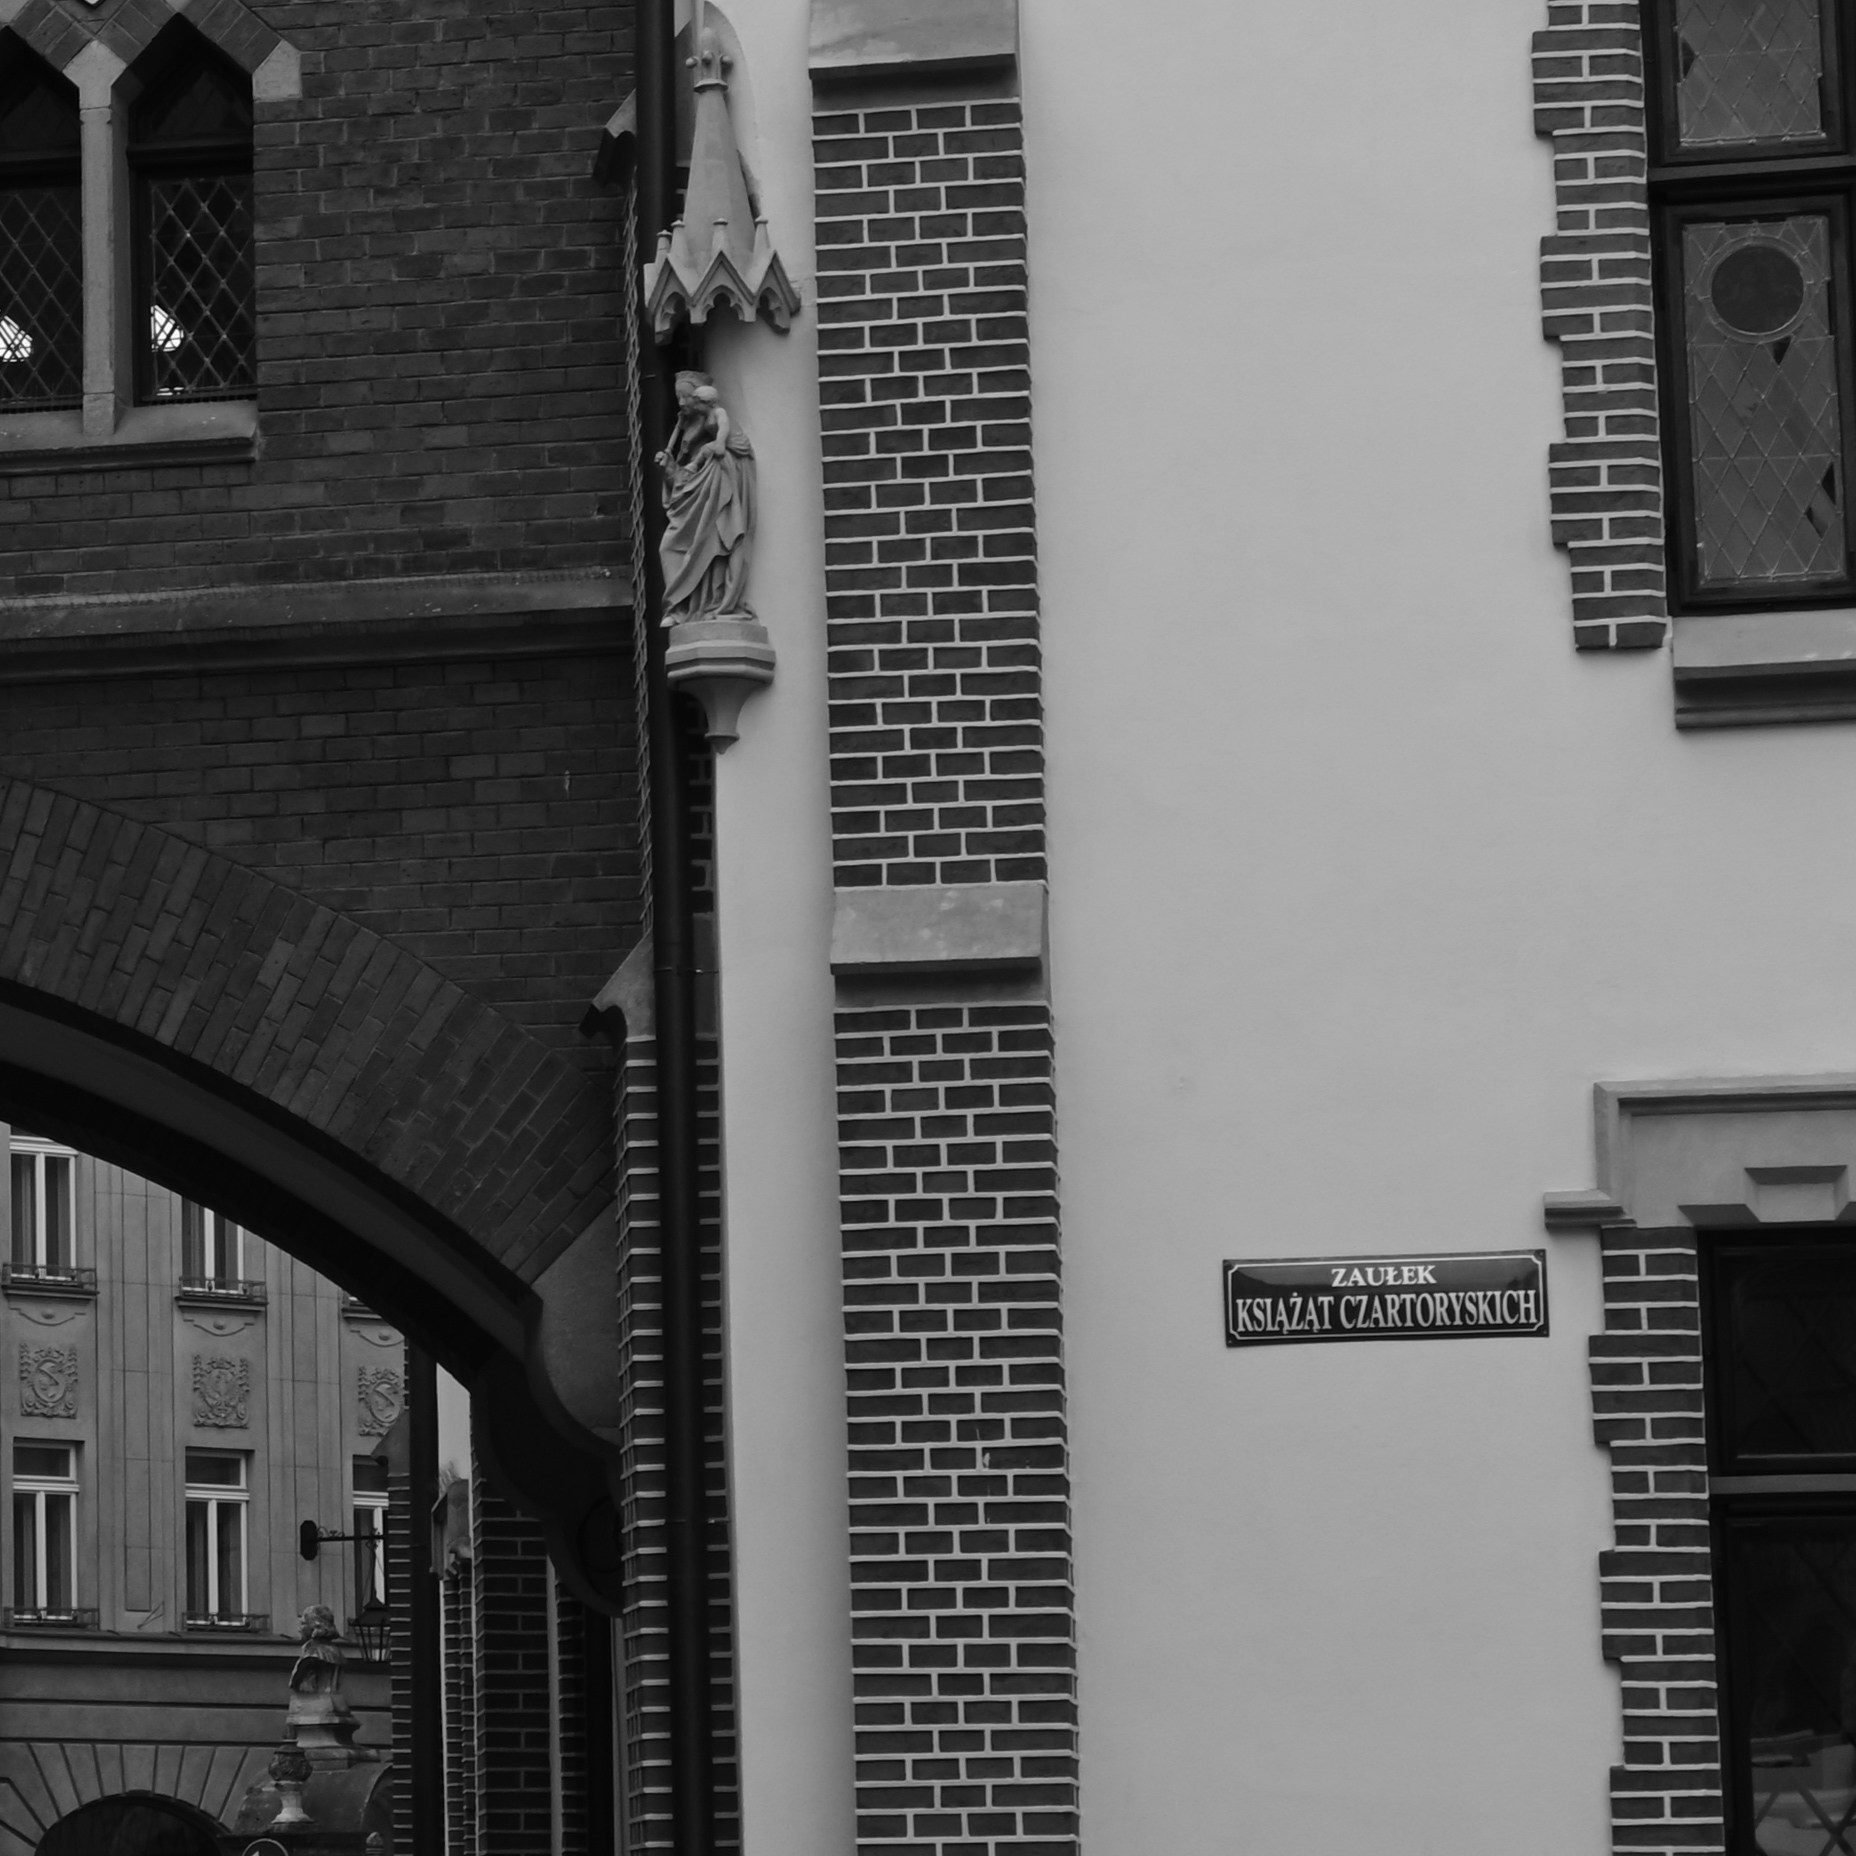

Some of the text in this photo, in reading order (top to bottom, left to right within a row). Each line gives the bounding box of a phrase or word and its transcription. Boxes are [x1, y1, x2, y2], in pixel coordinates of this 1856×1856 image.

[1331, 1265, 1438, 1288] ZAUŁEK
[1235, 1289, 1538, 1335] KSIĄŻĄT CZARTORYSKICH
